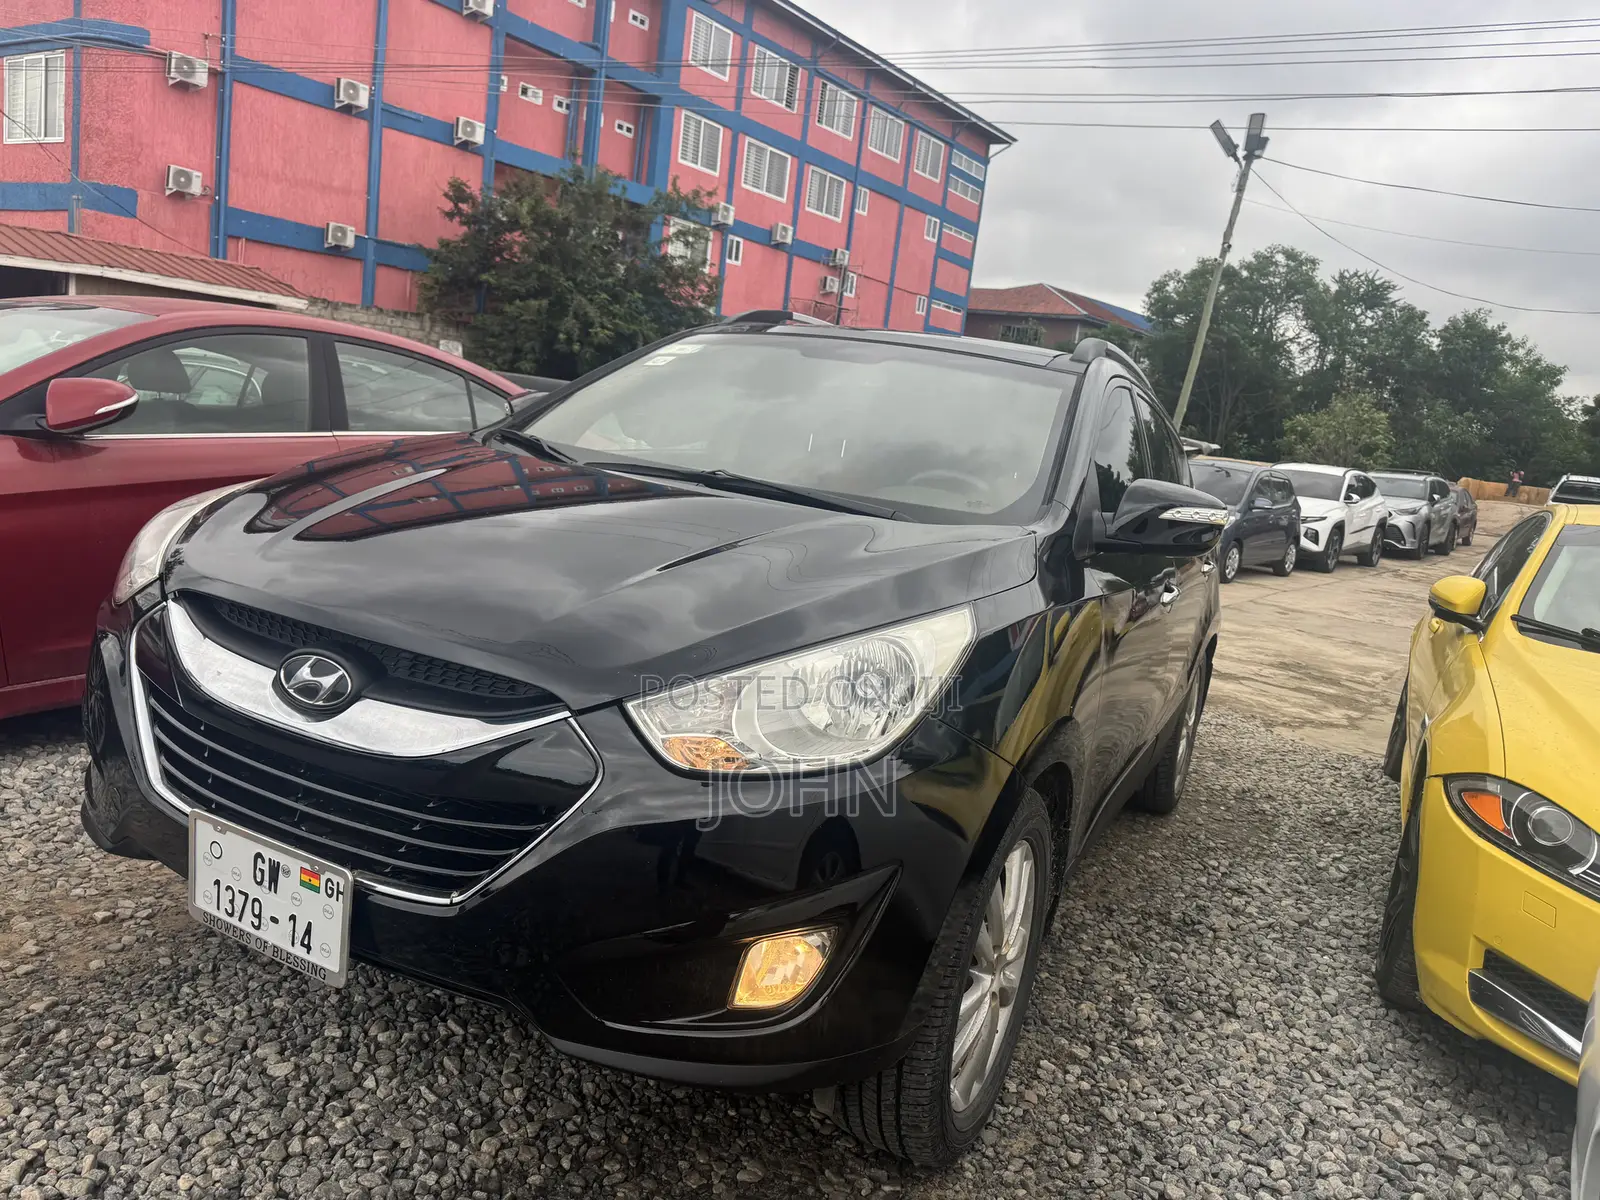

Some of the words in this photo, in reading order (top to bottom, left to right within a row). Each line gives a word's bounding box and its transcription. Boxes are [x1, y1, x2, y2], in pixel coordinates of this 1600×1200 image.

[253, 851, 280, 894] GW
[203, 911, 252, 945] SHOWERS
[255, 938, 271, 952] OF
[272, 944, 327, 980] BLESSING
